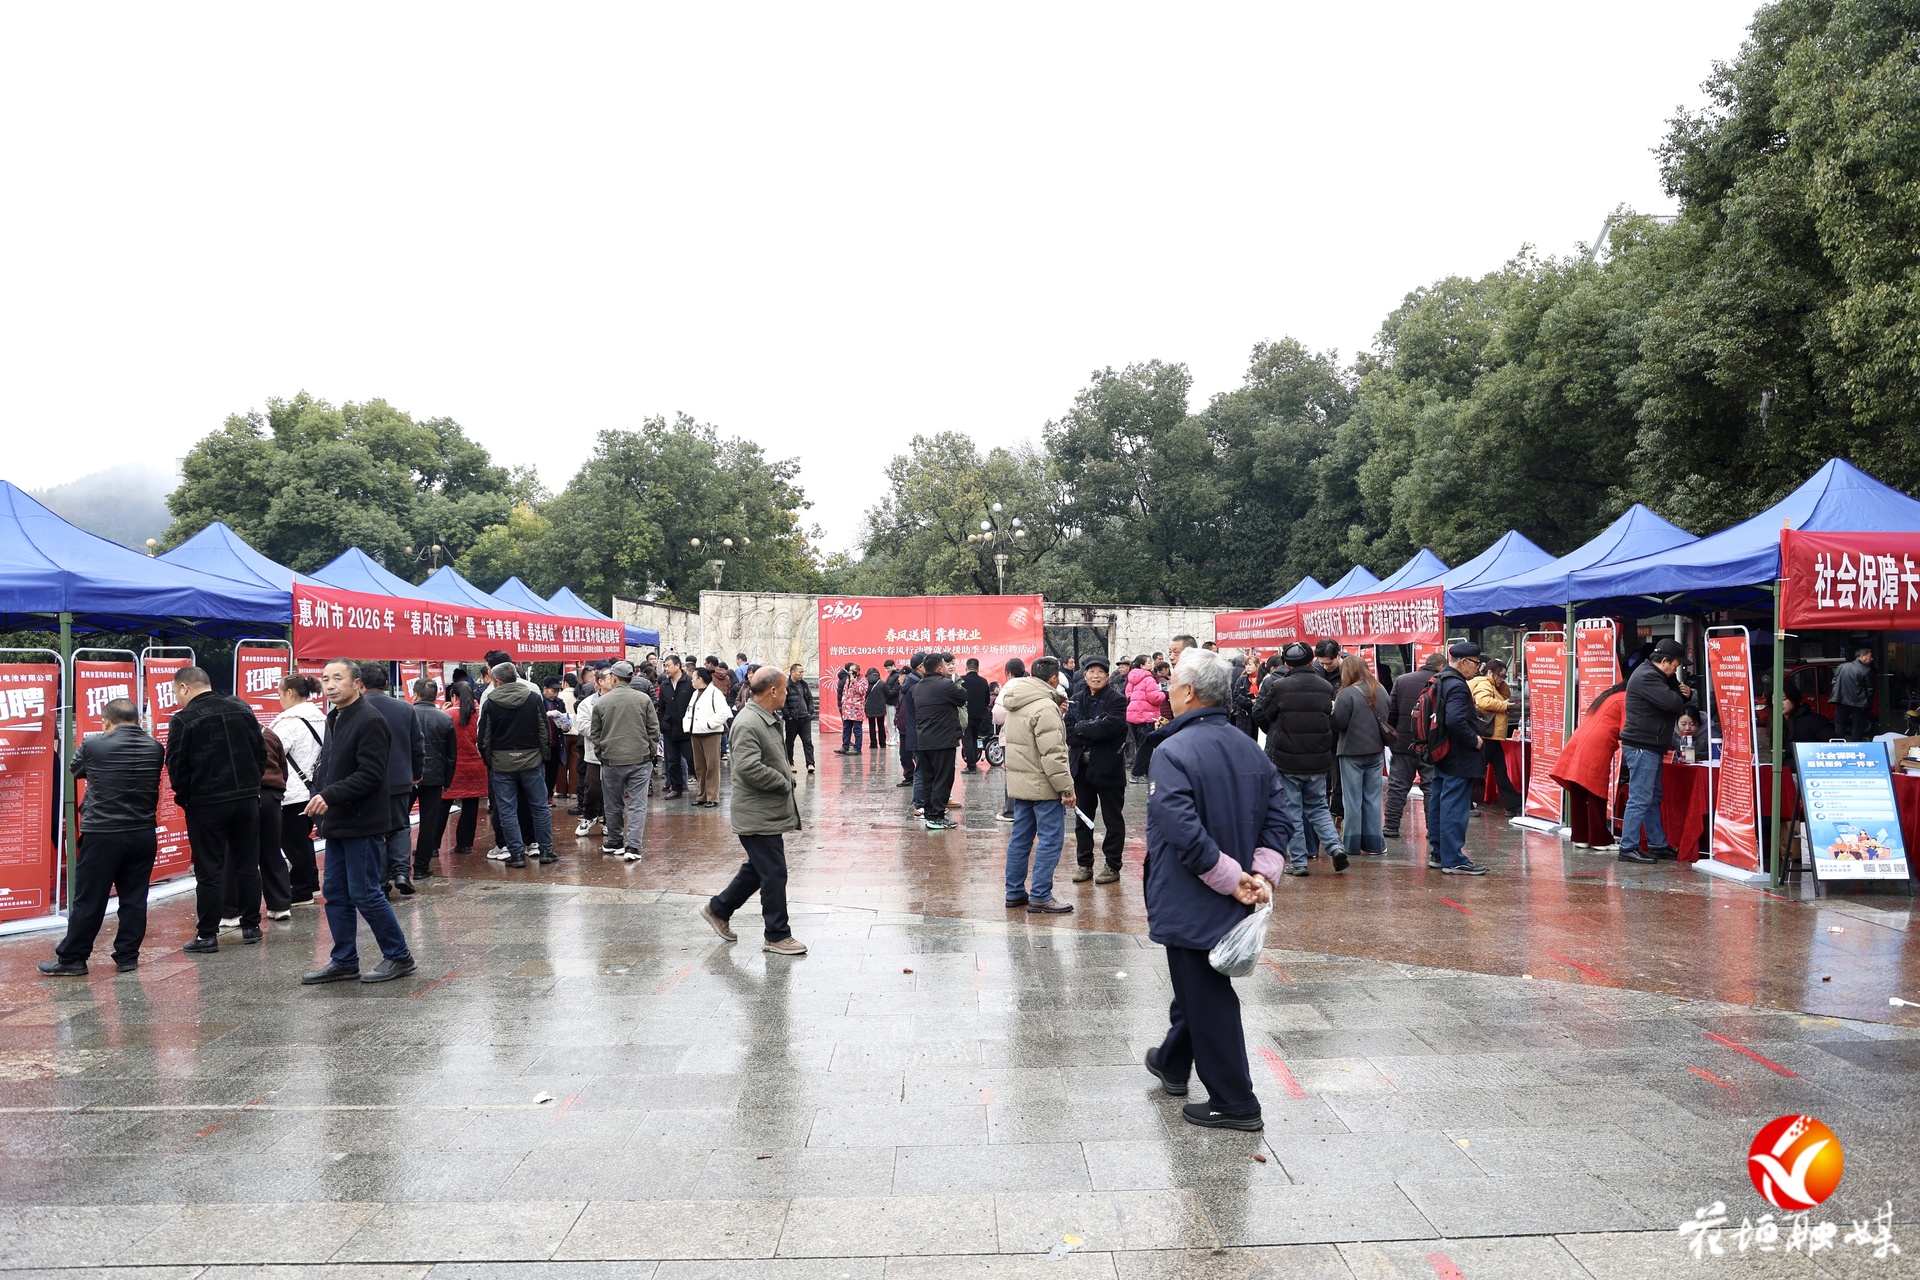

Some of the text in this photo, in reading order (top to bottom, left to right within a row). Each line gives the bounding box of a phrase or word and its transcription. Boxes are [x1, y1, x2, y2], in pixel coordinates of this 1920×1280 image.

[1814, 551, 1920, 611] 社会保障卡
[884, 627, 982, 643] 春风送岗 靠普就业
[829, 643, 1037, 657] 普陀区2026年春风行动暨就业援助季专场招聘活动
[0, 673, 53, 683] 电池有限公司
[245, 666, 282, 693] 招聘
[0, 687, 45, 721] 聘
[155, 680, 179, 710] 招
[1815, 751, 1867, 760] 社会保障卡
